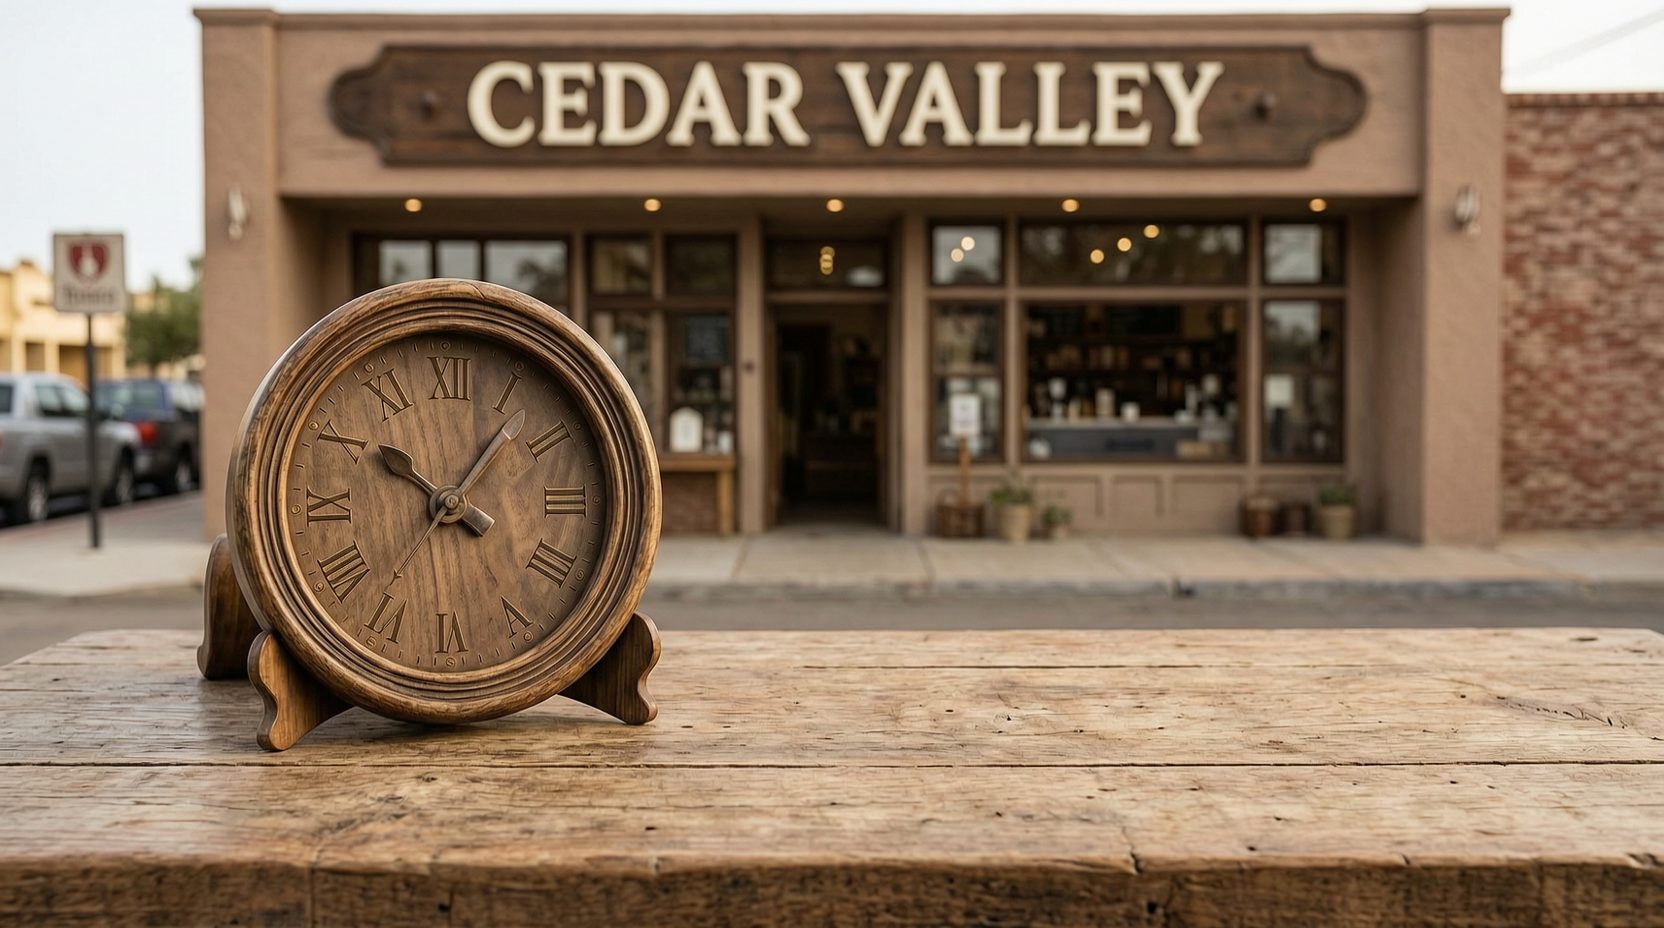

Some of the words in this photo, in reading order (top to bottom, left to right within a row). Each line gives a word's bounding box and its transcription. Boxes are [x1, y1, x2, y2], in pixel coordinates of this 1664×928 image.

[466, 60, 811, 148] CEDAR
[834, 60, 1224, 147] VALLEY
[361, 368, 414, 422] XI
[427, 356, 472, 401] XII
[317, 419, 369, 465] X
[525, 418, 575, 464] II
[306, 485, 351, 527] IX
[543, 485, 587, 519] III
